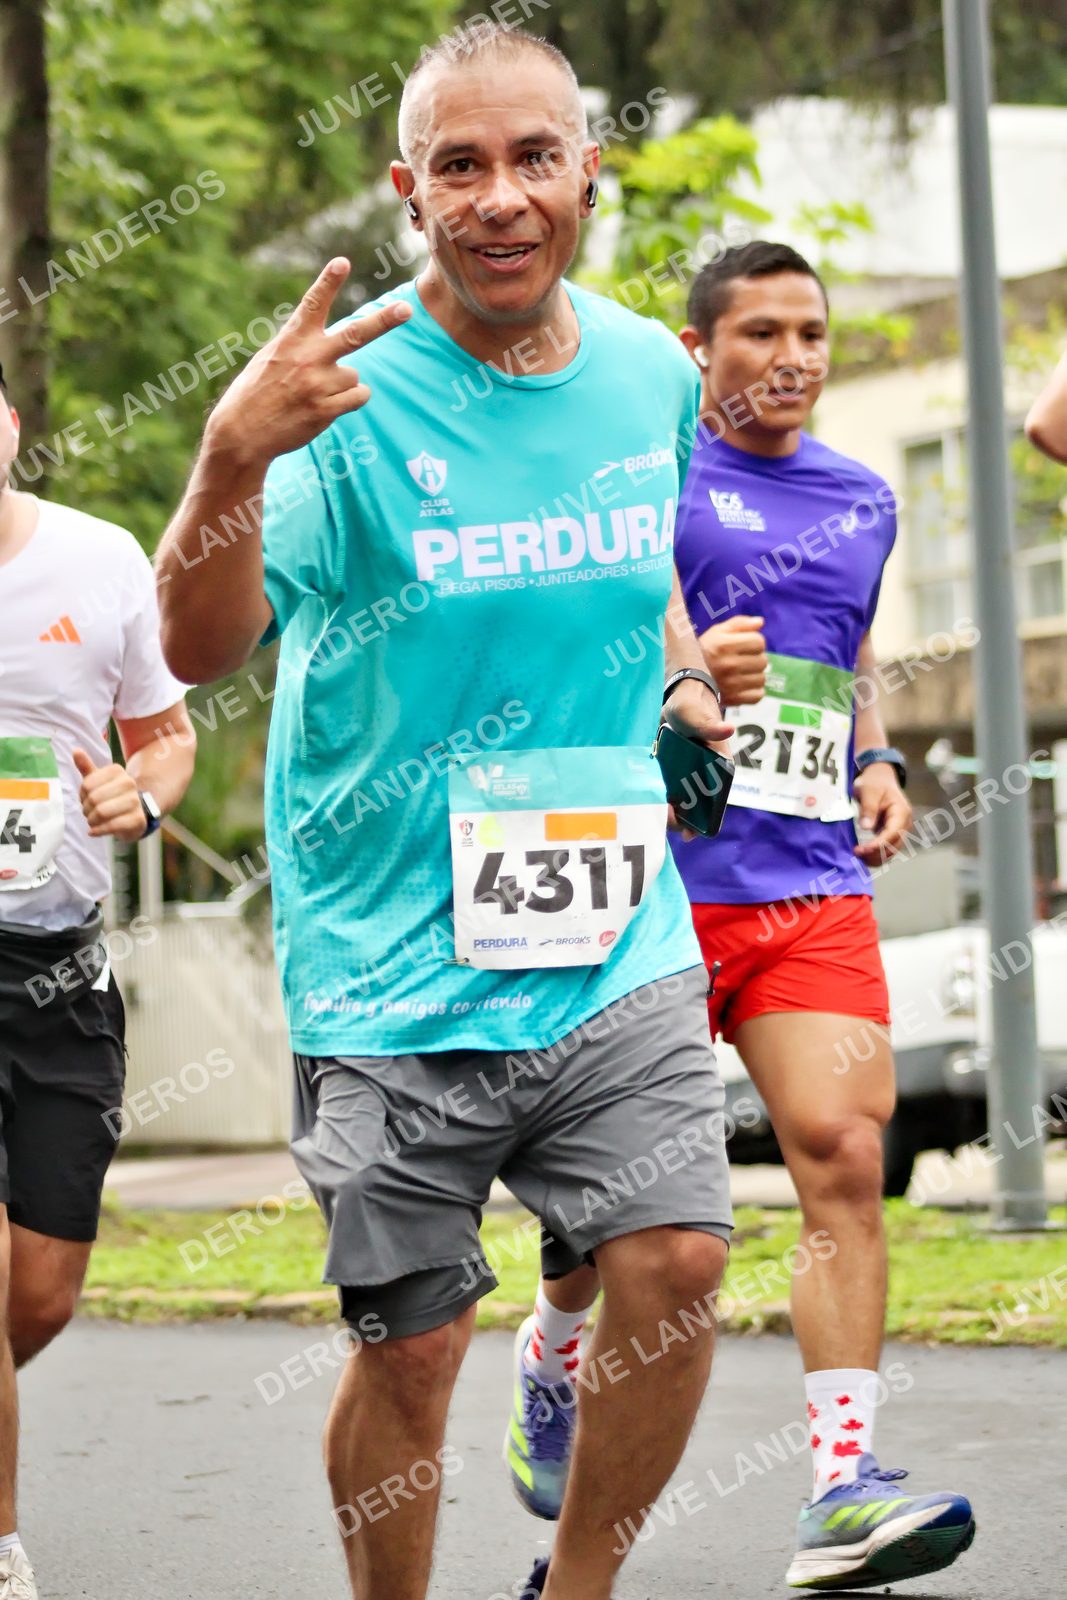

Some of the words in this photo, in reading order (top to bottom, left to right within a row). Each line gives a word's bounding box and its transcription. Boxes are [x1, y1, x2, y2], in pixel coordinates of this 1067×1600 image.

[419, 506, 455, 519] ATLAS
[420, 498, 450, 509] CLUB
[411, 497, 674, 582] PERDURA
[440, 580, 482, 596] PEGA
[485, 576, 526, 592] PISOS
[535, 564, 629, 588] JUNTEADORES
[735, 724, 839, 786] 2134
[473, 844, 645, 915] 4311
[473, 936, 528, 949] PERDURA
[555, 936, 591, 946] BROOKS
